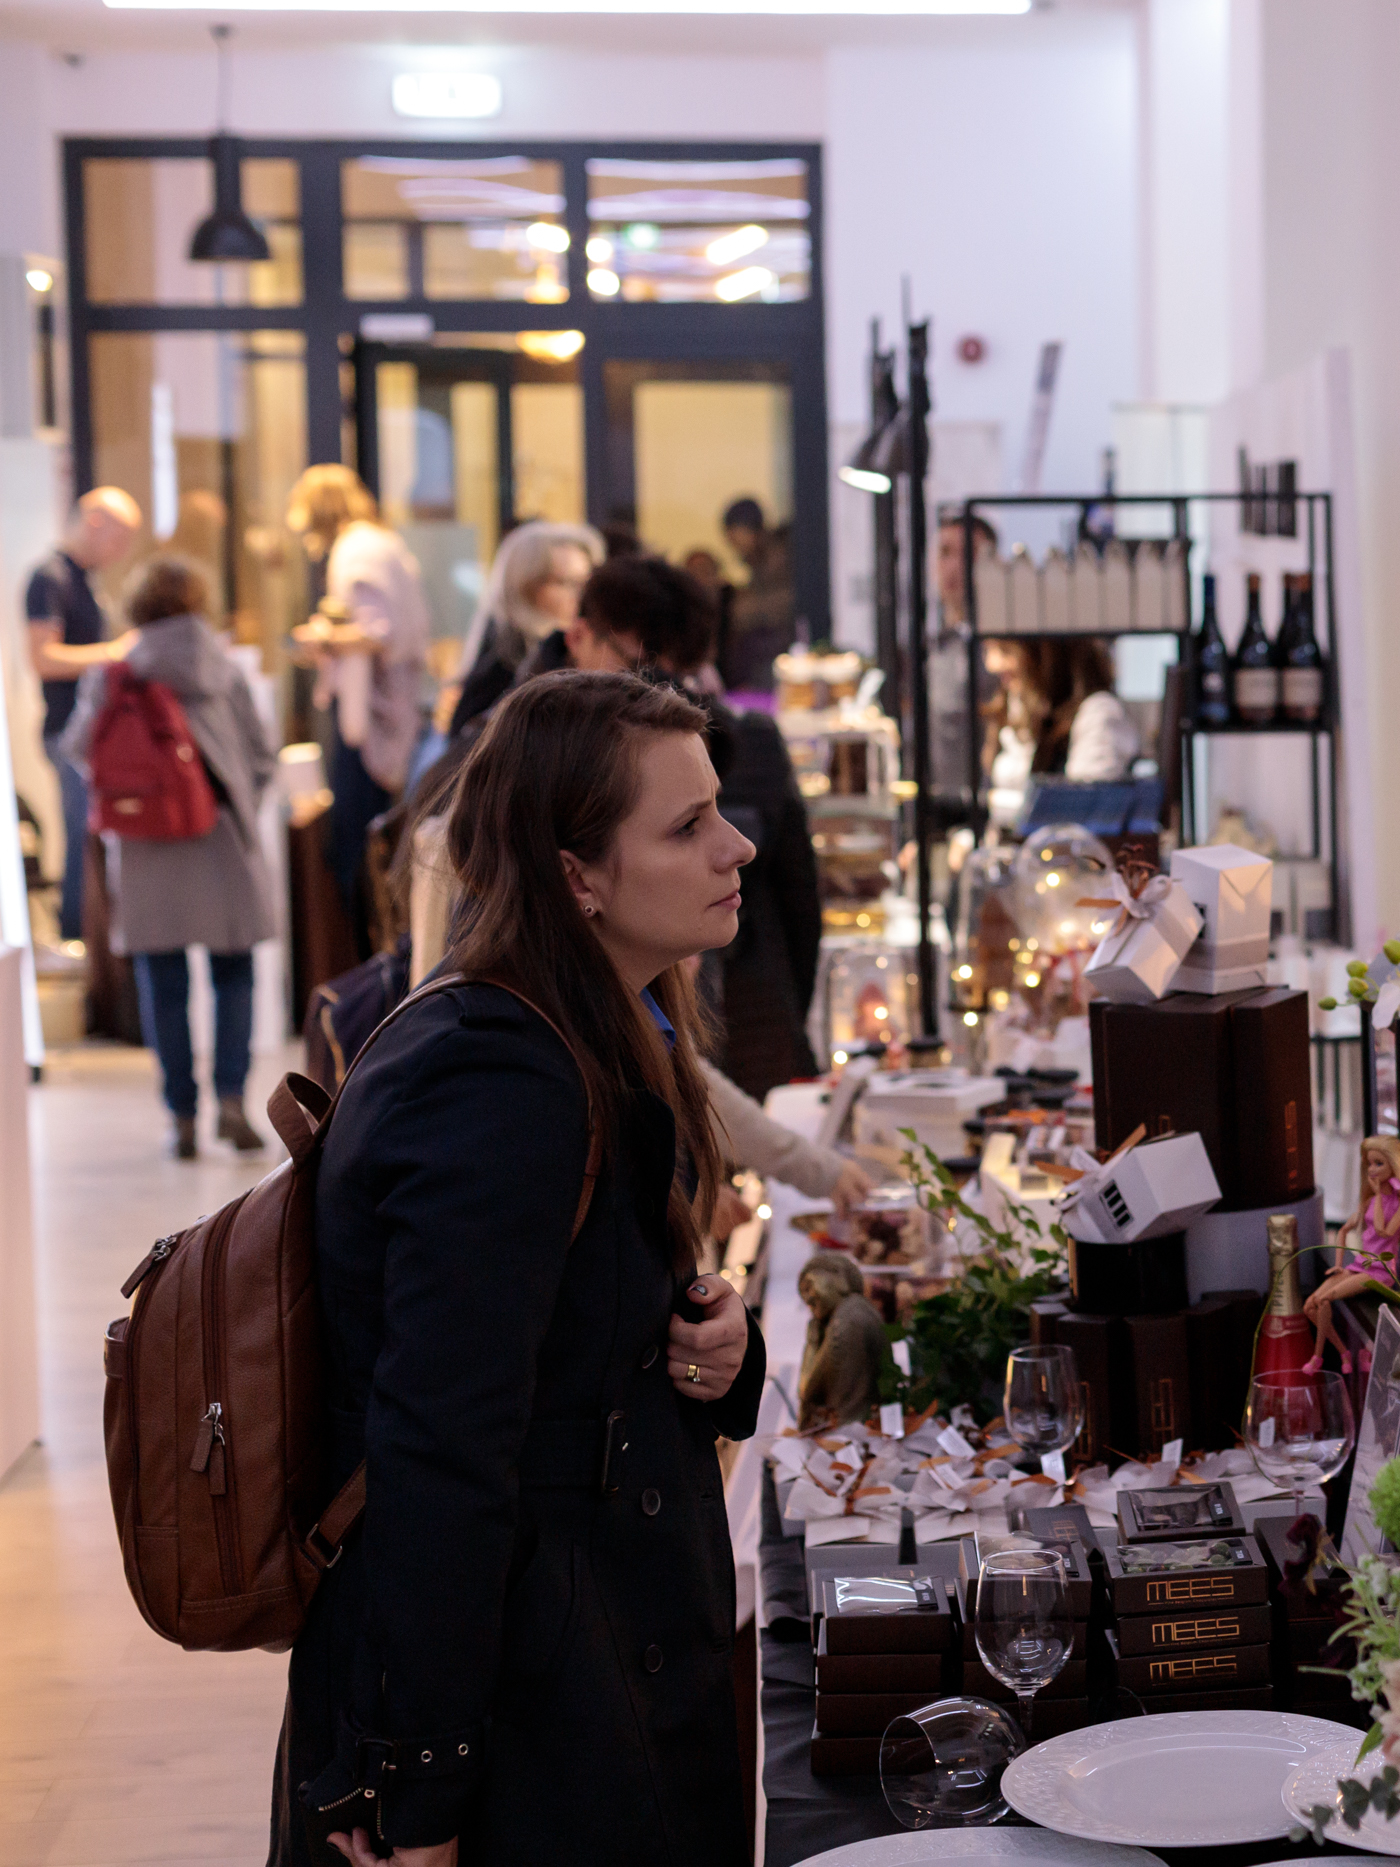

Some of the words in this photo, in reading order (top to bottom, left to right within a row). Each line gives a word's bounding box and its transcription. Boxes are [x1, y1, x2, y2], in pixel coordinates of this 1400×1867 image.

[1147, 1576, 1234, 1602] MEES
[1152, 1616, 1240, 1643] MEES
[1150, 1655, 1237, 1680] MEES
